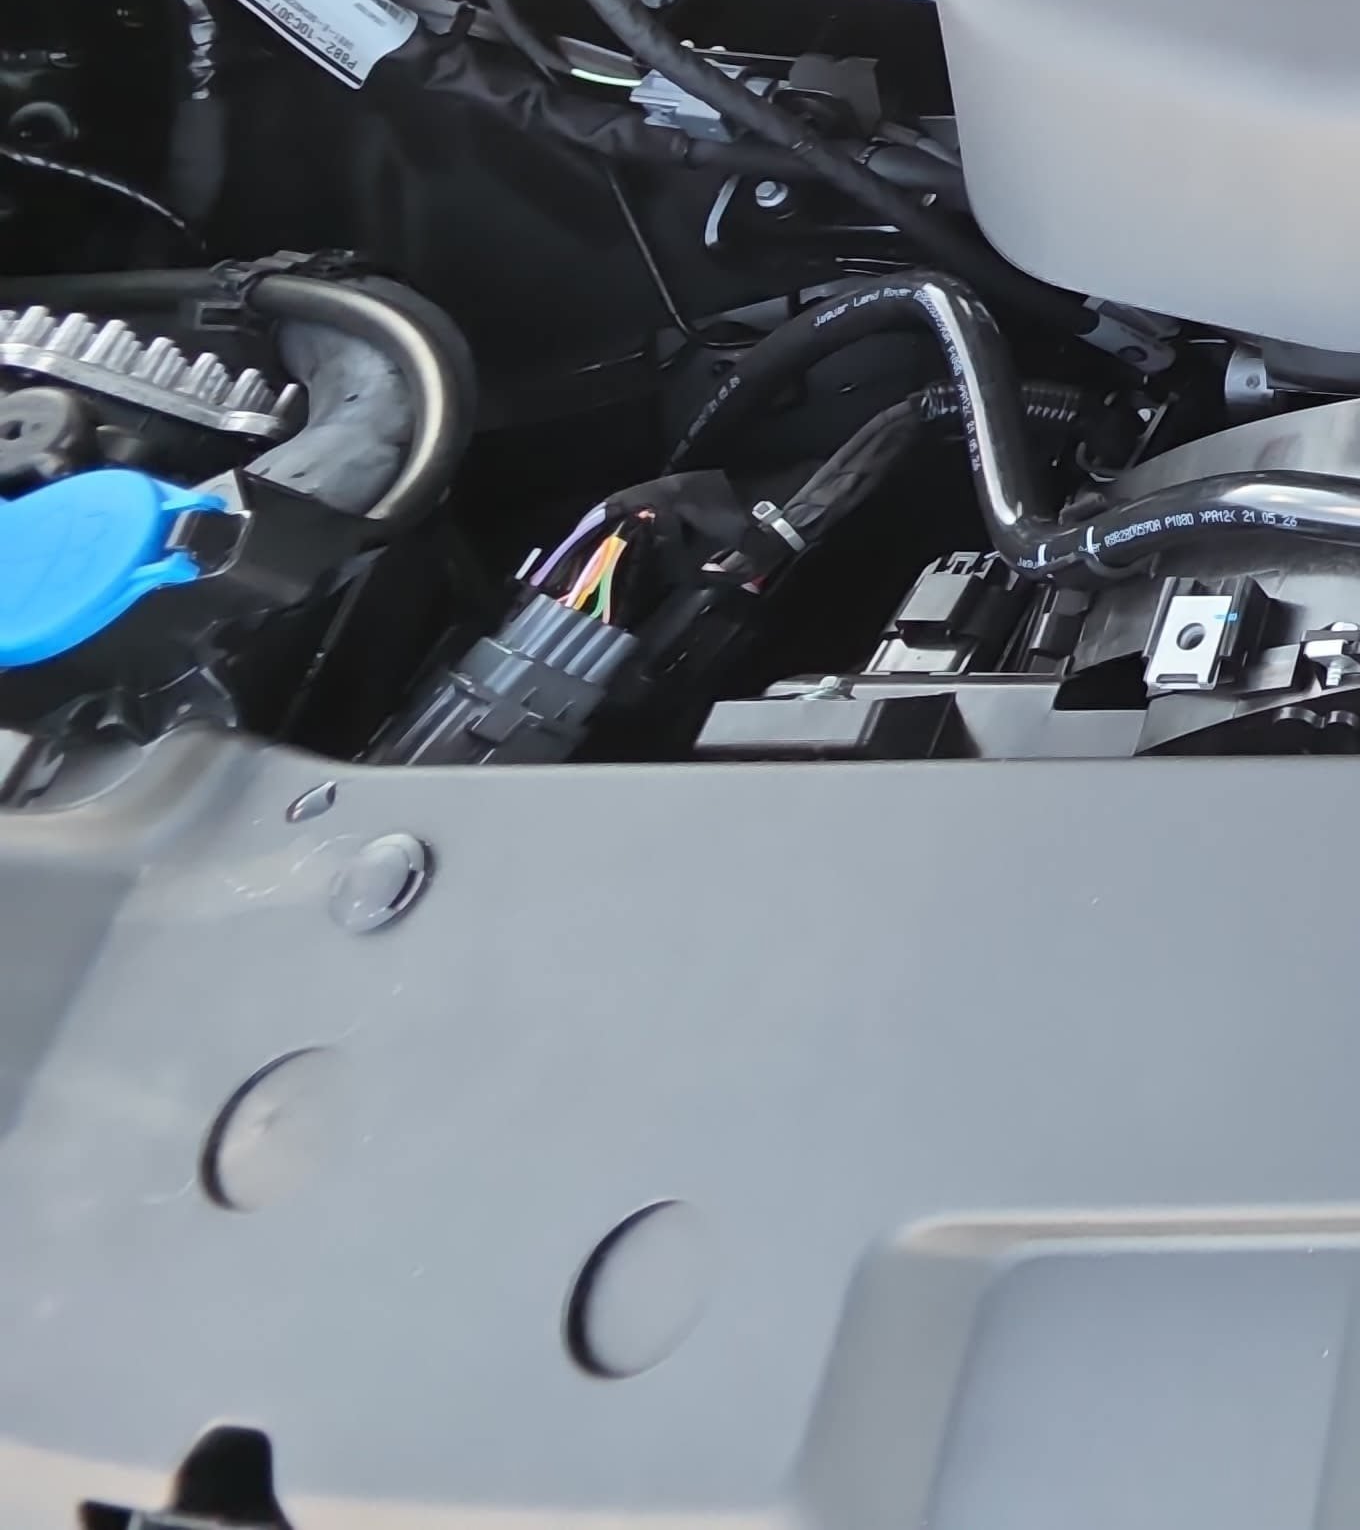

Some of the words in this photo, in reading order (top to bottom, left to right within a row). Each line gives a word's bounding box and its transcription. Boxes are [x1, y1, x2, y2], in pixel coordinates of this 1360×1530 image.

[813, 303, 848, 327] Jaguar
[853, 290, 880, 308] Land
[883, 287, 912, 297] Rover
